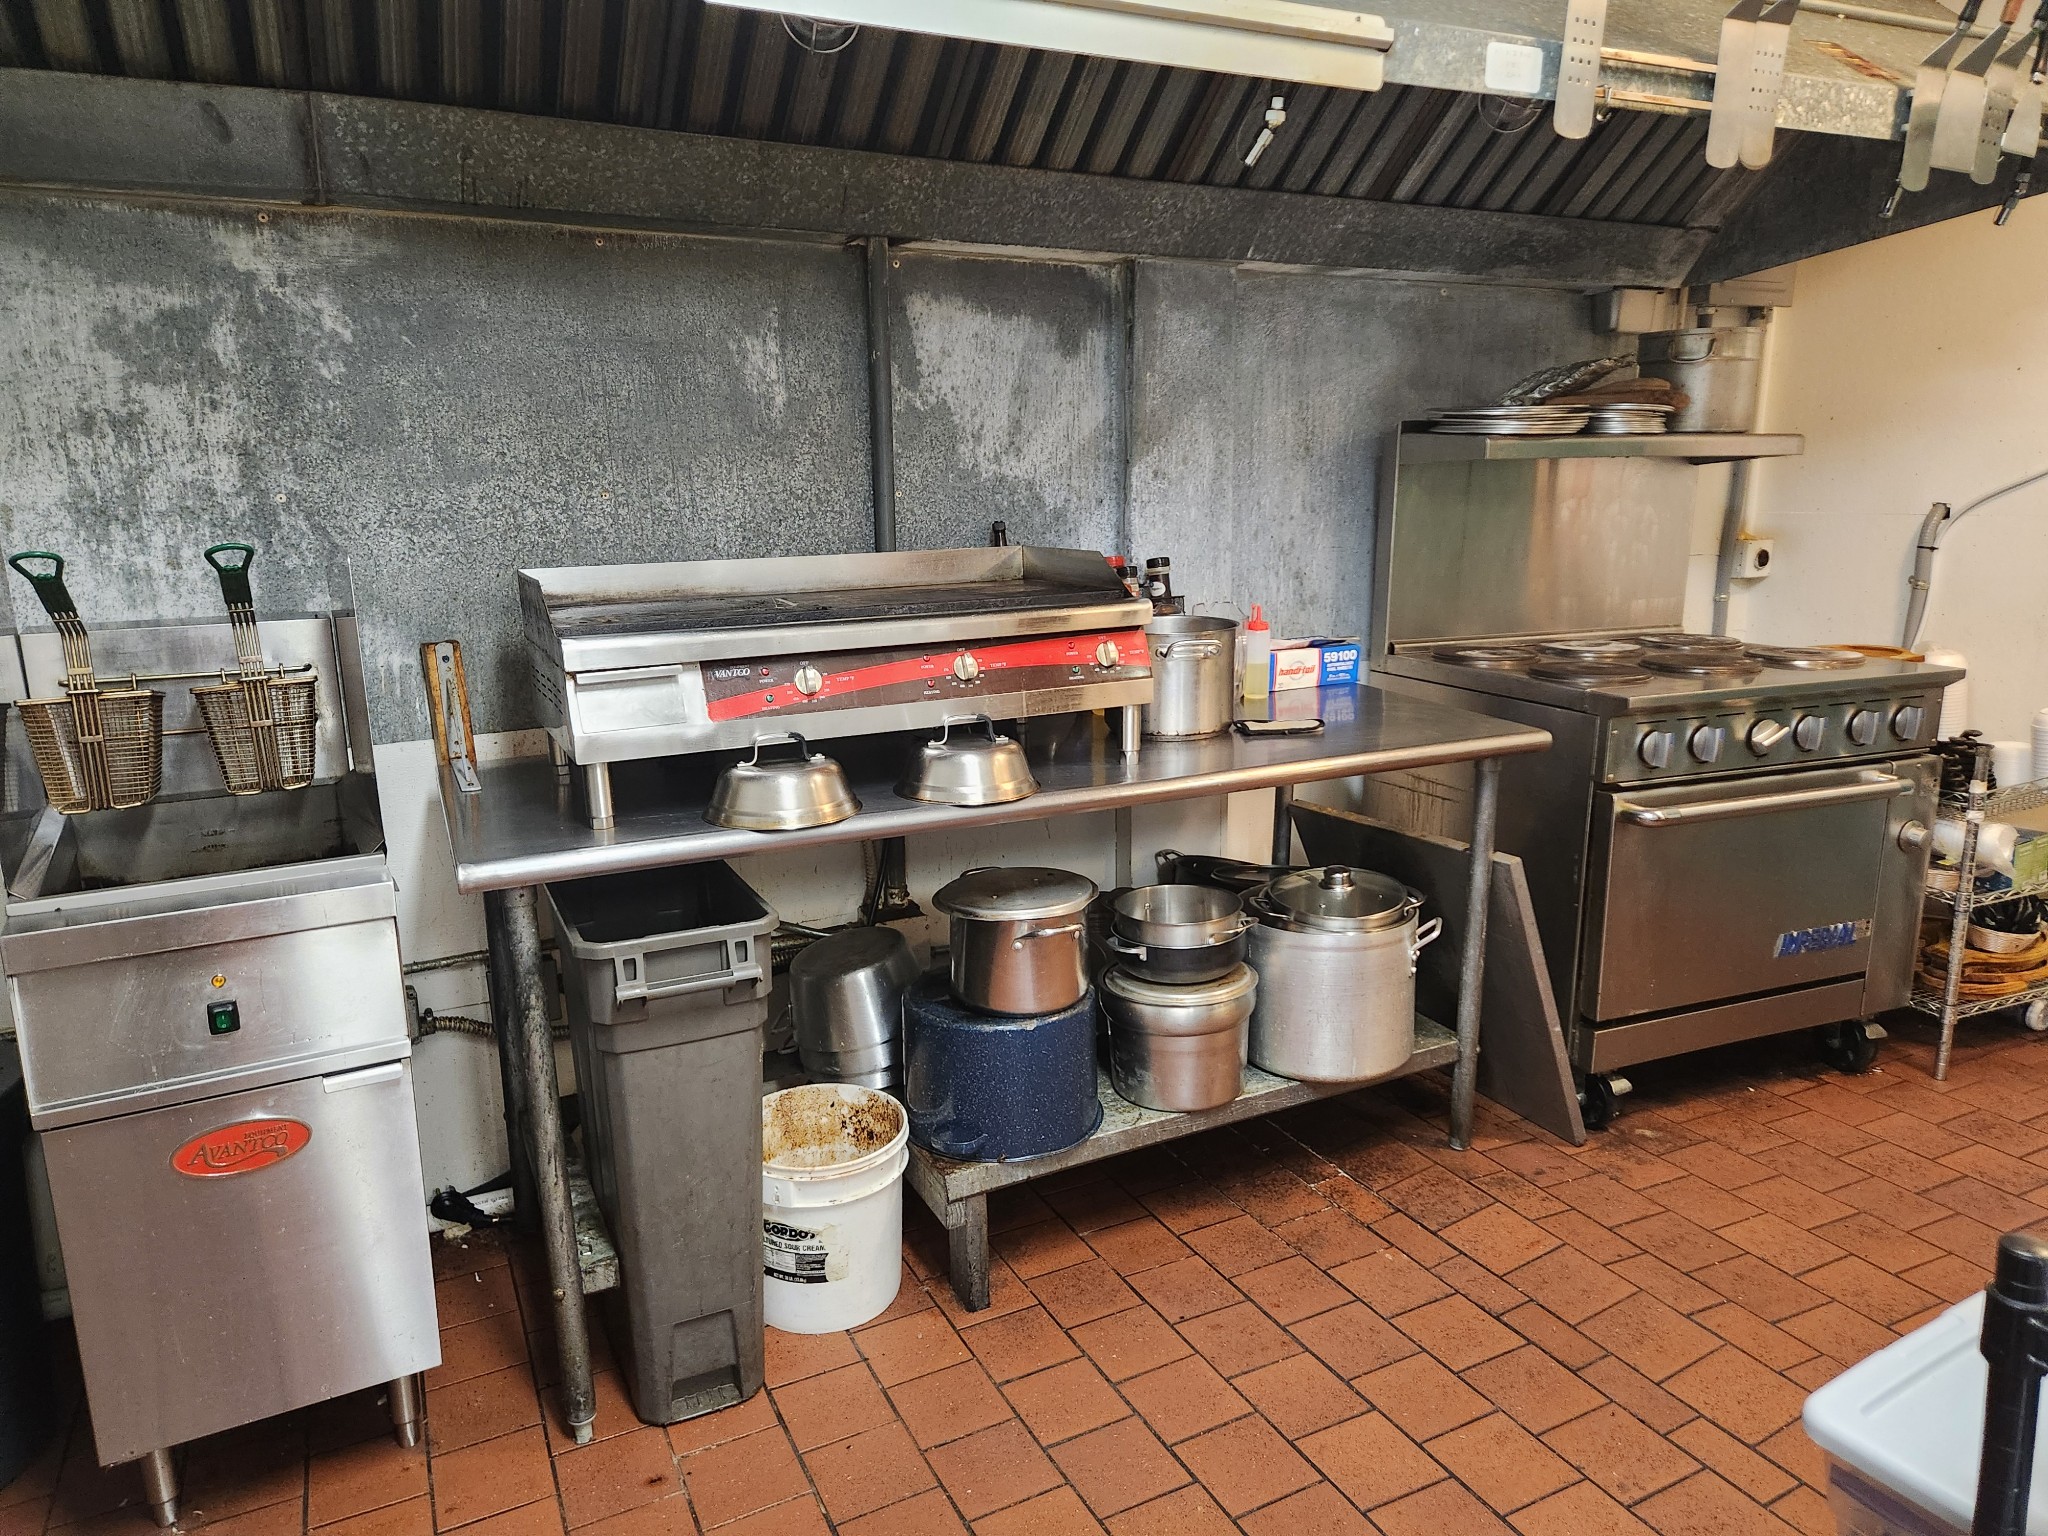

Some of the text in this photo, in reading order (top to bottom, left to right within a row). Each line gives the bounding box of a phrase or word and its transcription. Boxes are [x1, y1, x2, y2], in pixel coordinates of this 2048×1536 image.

[1324, 650, 1357, 662] 59100
[244, 1124, 288, 1139] EQUIPMENT
[187, 1131, 288, 1168] AVANTCO
[784, 1243, 801, 1251] SOUR
